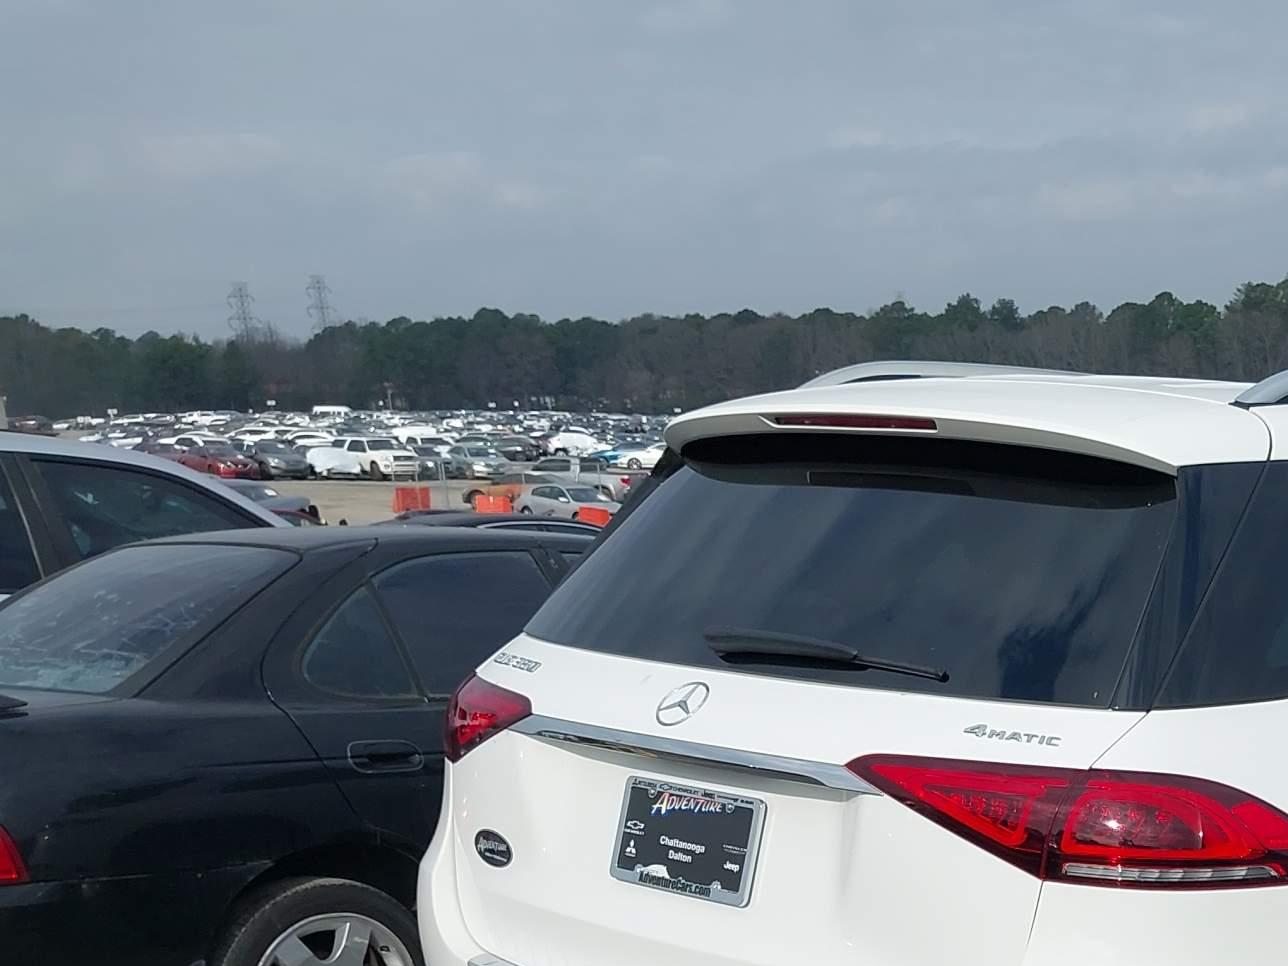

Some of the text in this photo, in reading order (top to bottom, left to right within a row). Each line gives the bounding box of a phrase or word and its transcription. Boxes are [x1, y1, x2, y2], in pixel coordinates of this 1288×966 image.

[963, 724, 1062, 747] 4MATIC
[650, 791, 723, 815] ADVENTURE
[659, 835, 706, 854] Chattanooga
[668, 850, 692, 863] Dalton
[638, 870, 711, 898] AdventureCars.com
